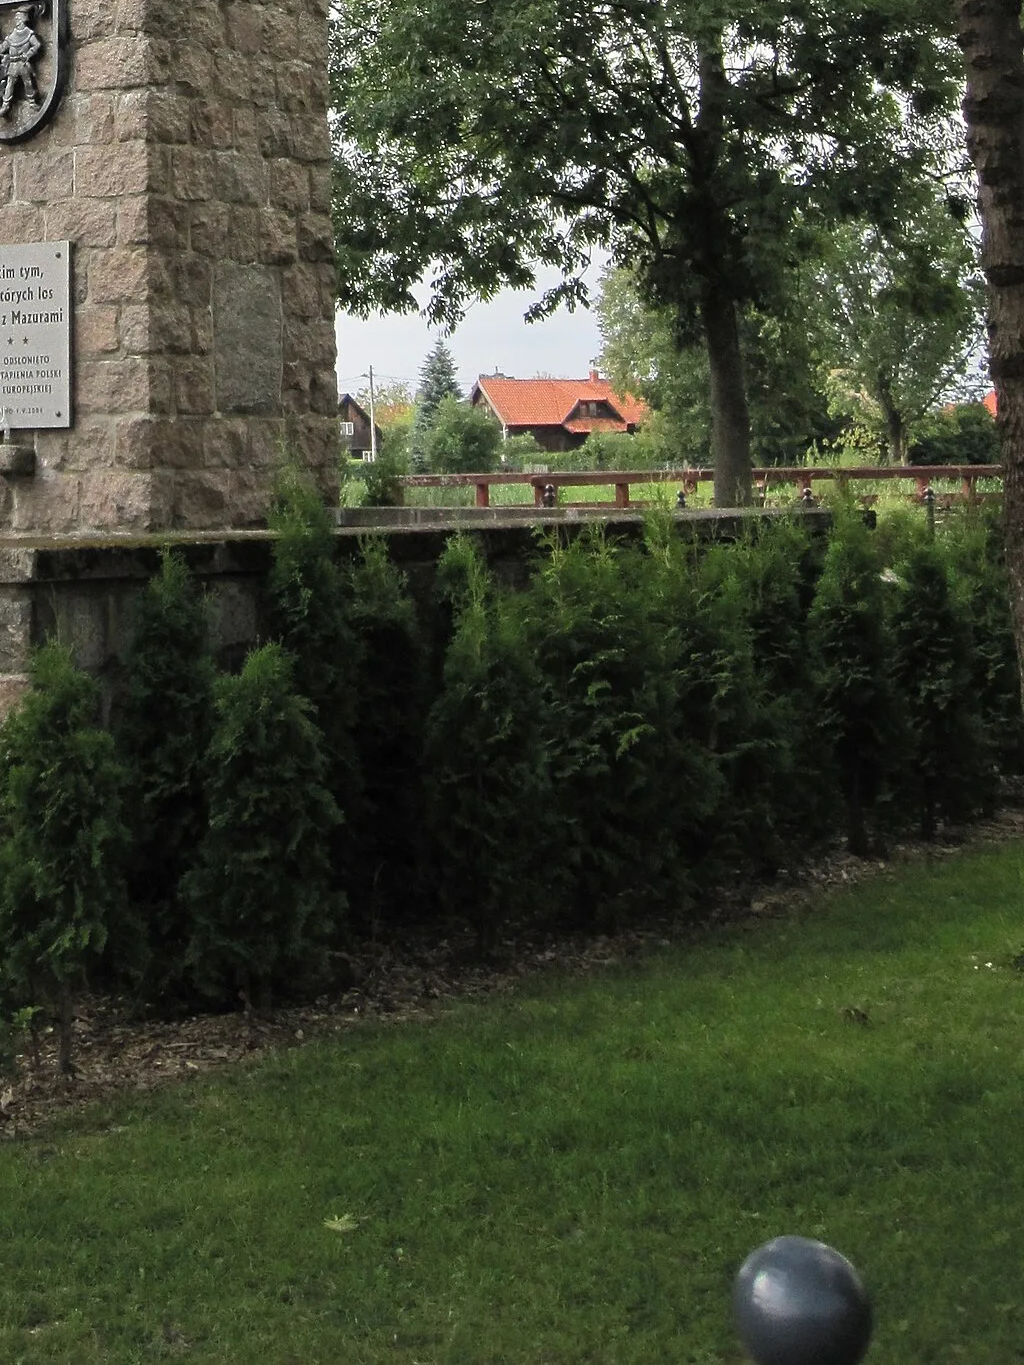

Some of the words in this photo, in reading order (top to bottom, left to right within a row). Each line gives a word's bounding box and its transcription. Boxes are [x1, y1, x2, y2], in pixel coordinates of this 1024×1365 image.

[20, 266, 44, 280] tym,
[38, 286, 53, 300] los
[2, 315, 7, 325] z
[11, 308, 63, 325] Mazurami
[36, 369, 62, 378] POLSKI
[2, 384, 52, 395] EUROPEJSKIEJ
